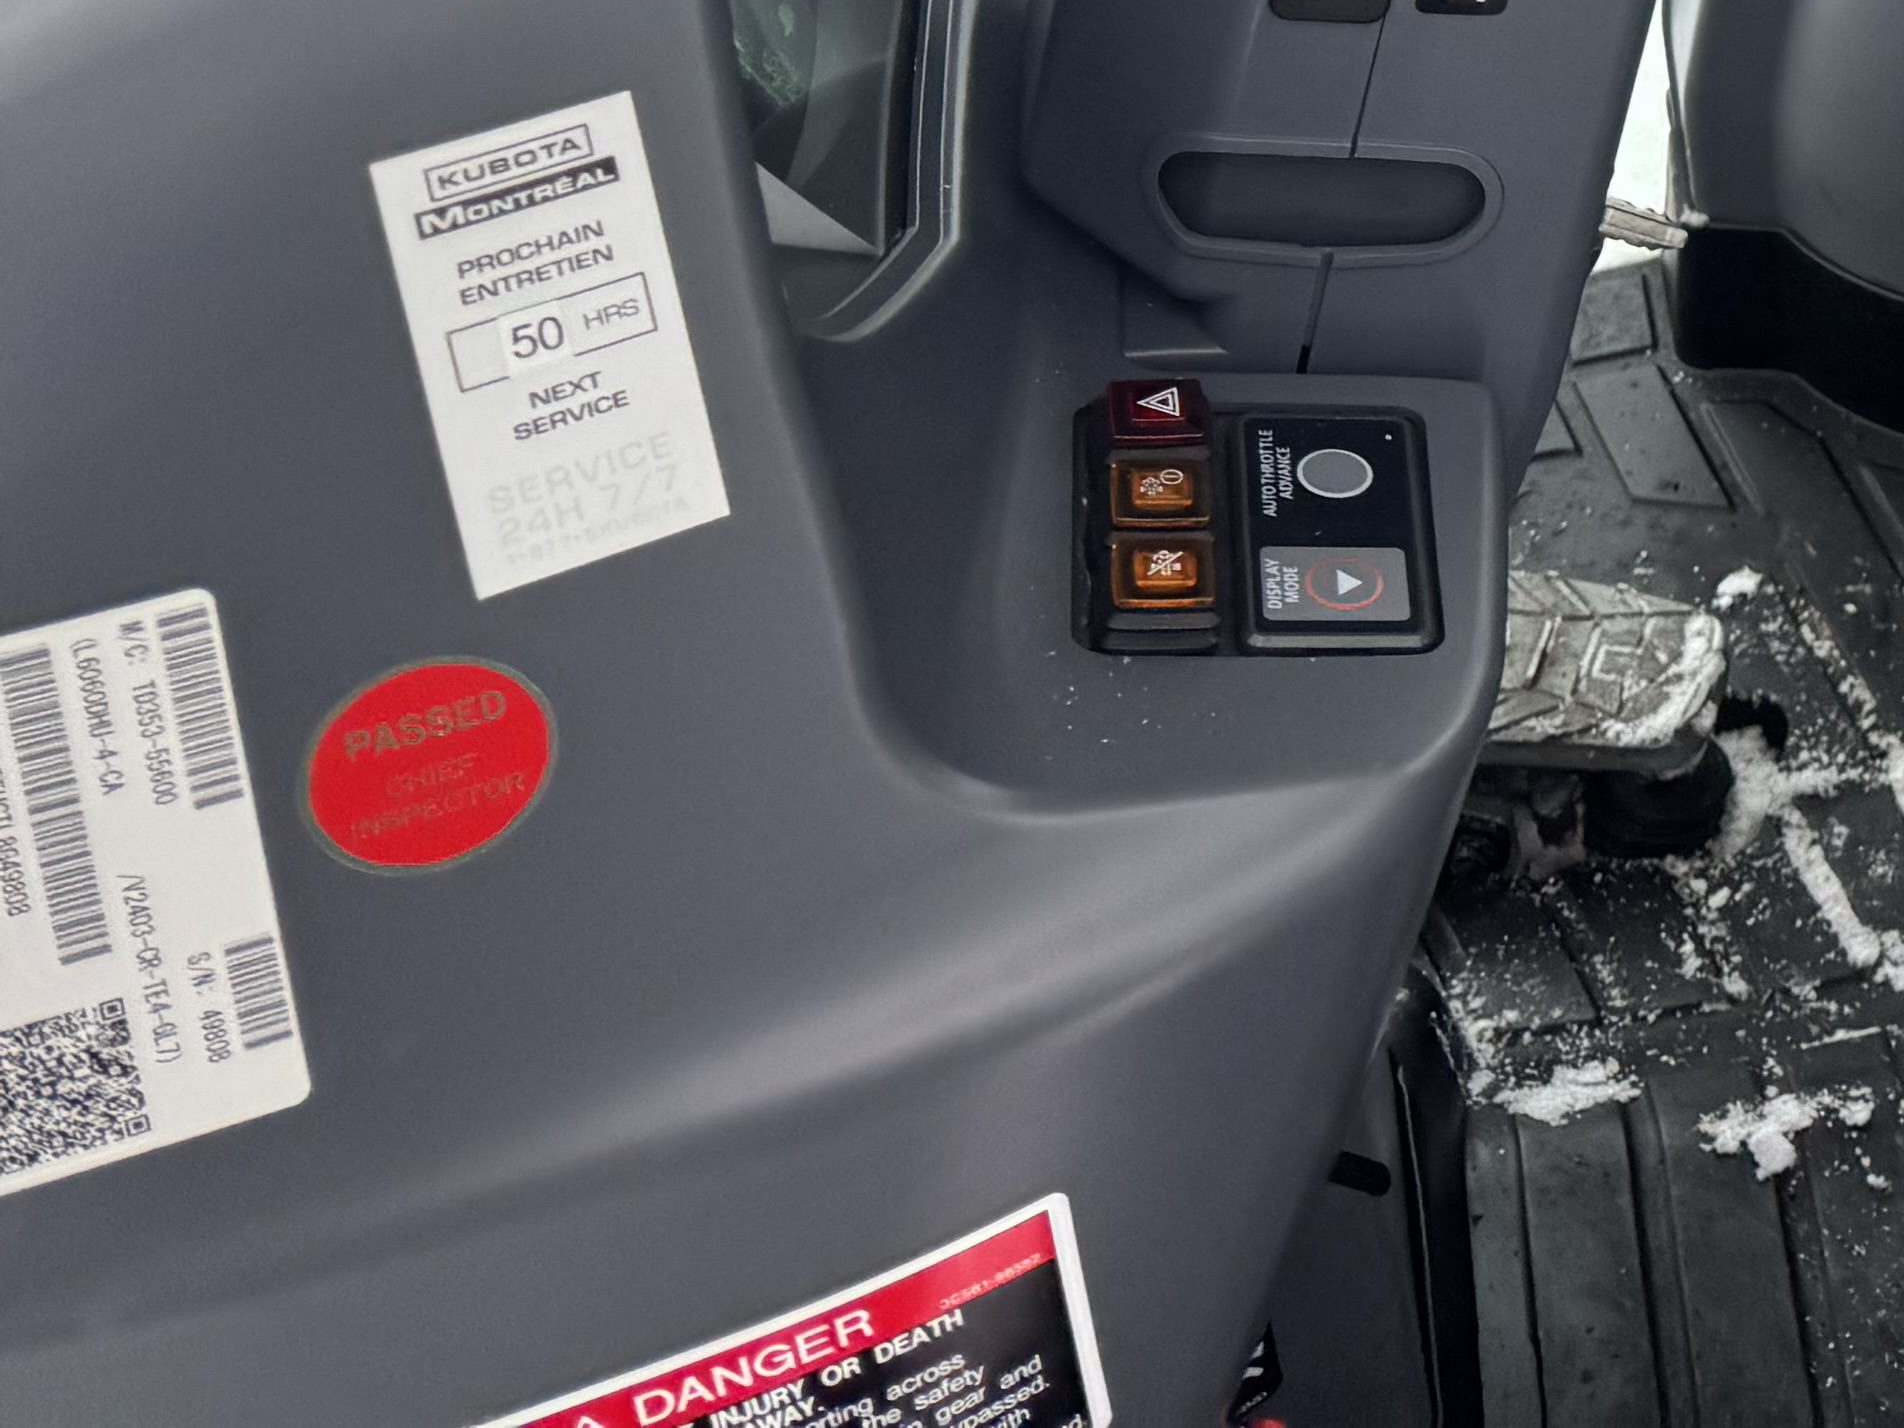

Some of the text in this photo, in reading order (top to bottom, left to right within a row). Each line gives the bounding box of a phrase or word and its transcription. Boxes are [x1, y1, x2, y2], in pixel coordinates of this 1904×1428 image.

[437, 137, 580, 189] KUBOTA
[457, 221, 603, 278] PROCHAIN
[459, 245, 613, 305] ENTRETIEN
[511, 297, 639, 358] 50 HRS
[513, 389, 628, 440] SERVICE
[528, 370, 599, 408] NEXT
[487, 431, 670, 514] SERVICE
[1258, 430, 1278, 516] AUTO THROTTLE
[1276, 446, 1294, 499] ADVANCE
[497, 495, 584, 546] 24H
[1265, 558, 1283, 609] DISPLAY
[1284, 566, 1299, 602] MODE
[118, 619, 150, 666] M/C:
[132, 680, 177, 805] TD353-55600
[344, 690, 507, 761] PASSED
[634, 1310, 871, 1424] DANGER
[710, 1379, 803, 1428] INJURY
[820, 1356, 860, 1386] OR
[873, 1308, 963, 1363] DEATH
[886, 1353, 965, 1400] across
[914, 1365, 983, 1410] safety
[934, 1386, 985, 1426] gear
[999, 1354, 1042, 1389] and
